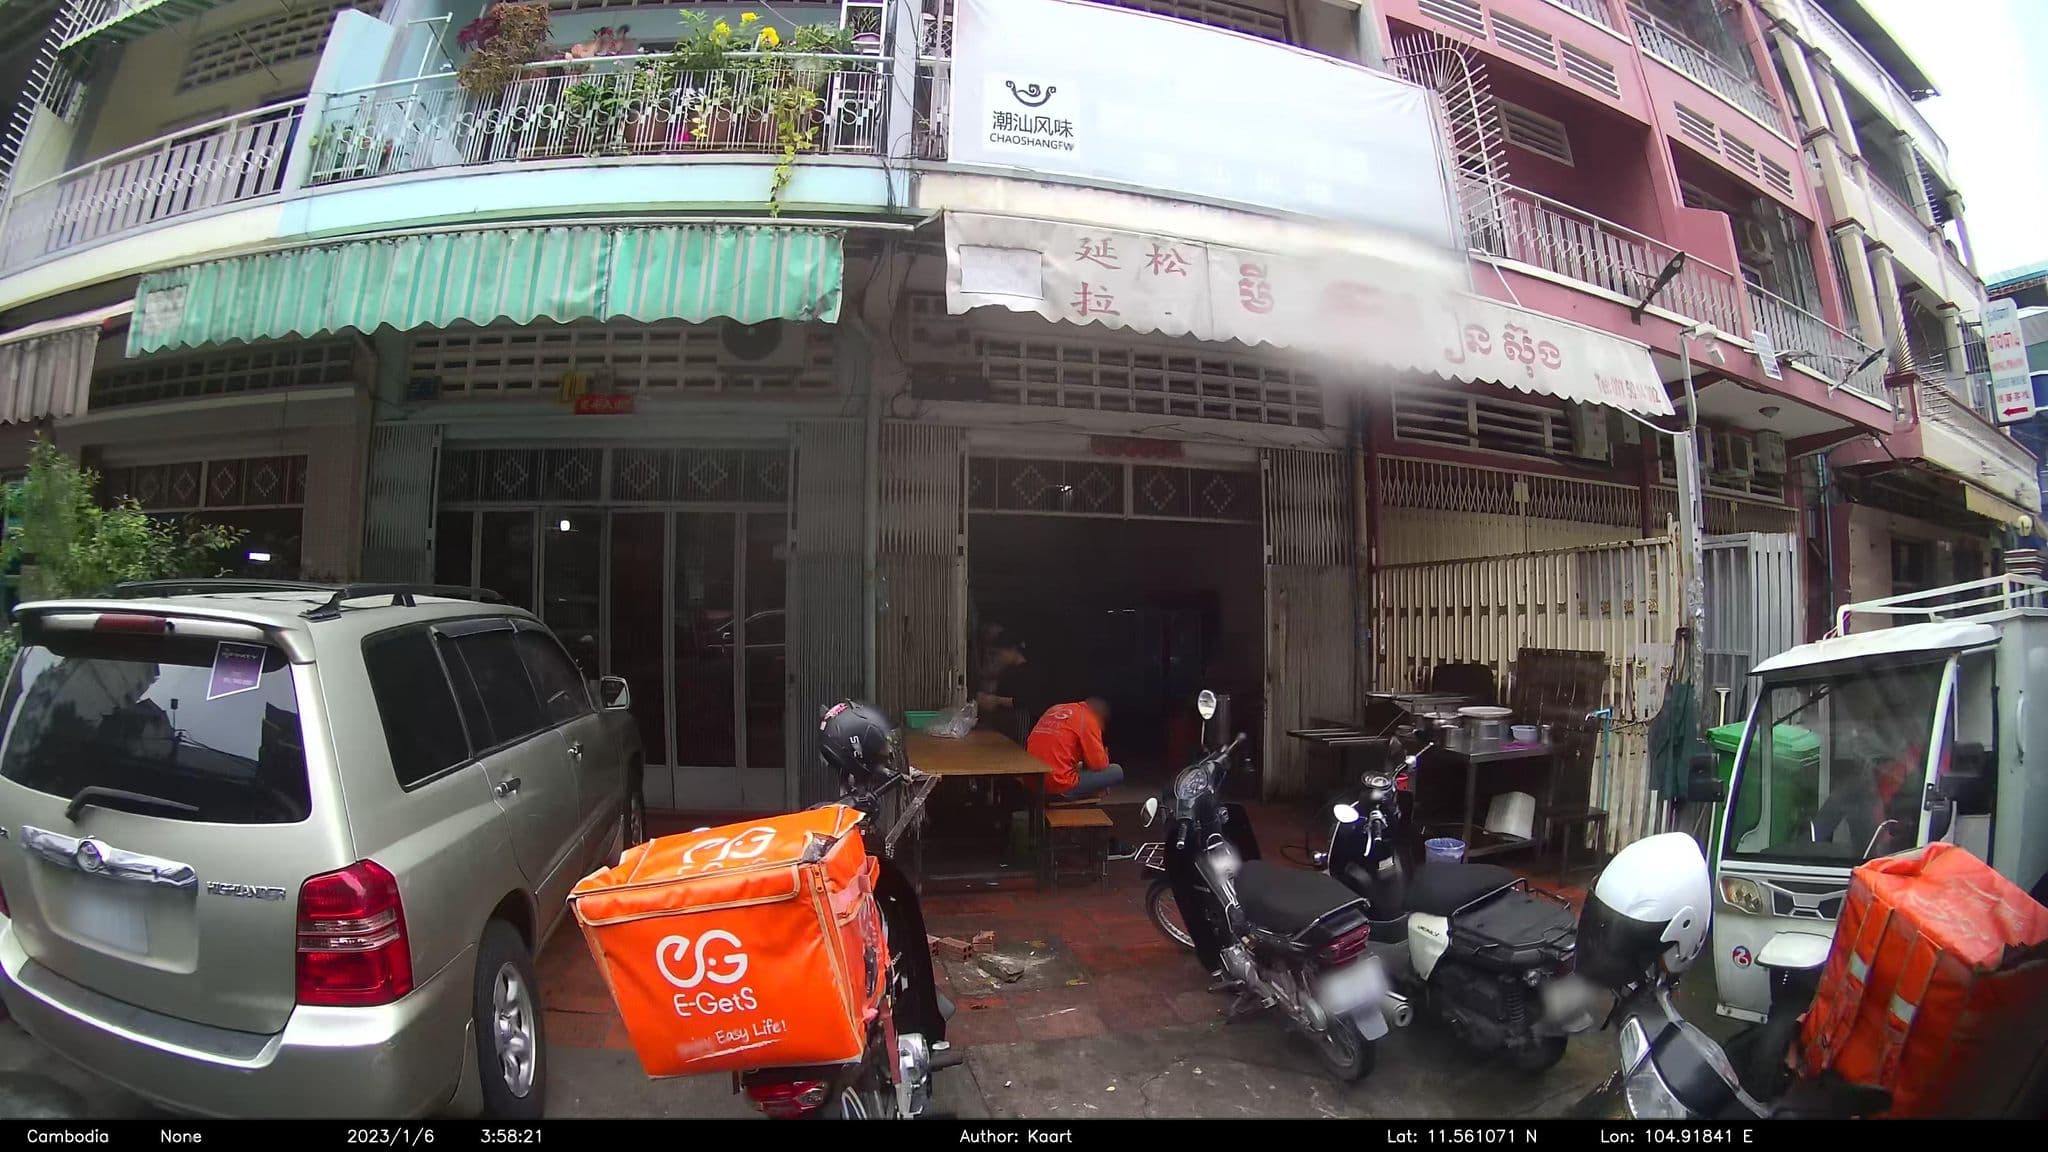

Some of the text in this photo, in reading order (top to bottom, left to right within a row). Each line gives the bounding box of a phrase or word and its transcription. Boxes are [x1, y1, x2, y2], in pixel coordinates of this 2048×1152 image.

[992, 110, 1074, 138] 潮汕风味
[673, 987, 759, 1017] E-GetS
[716, 1018, 788, 1044] Easy Life!
